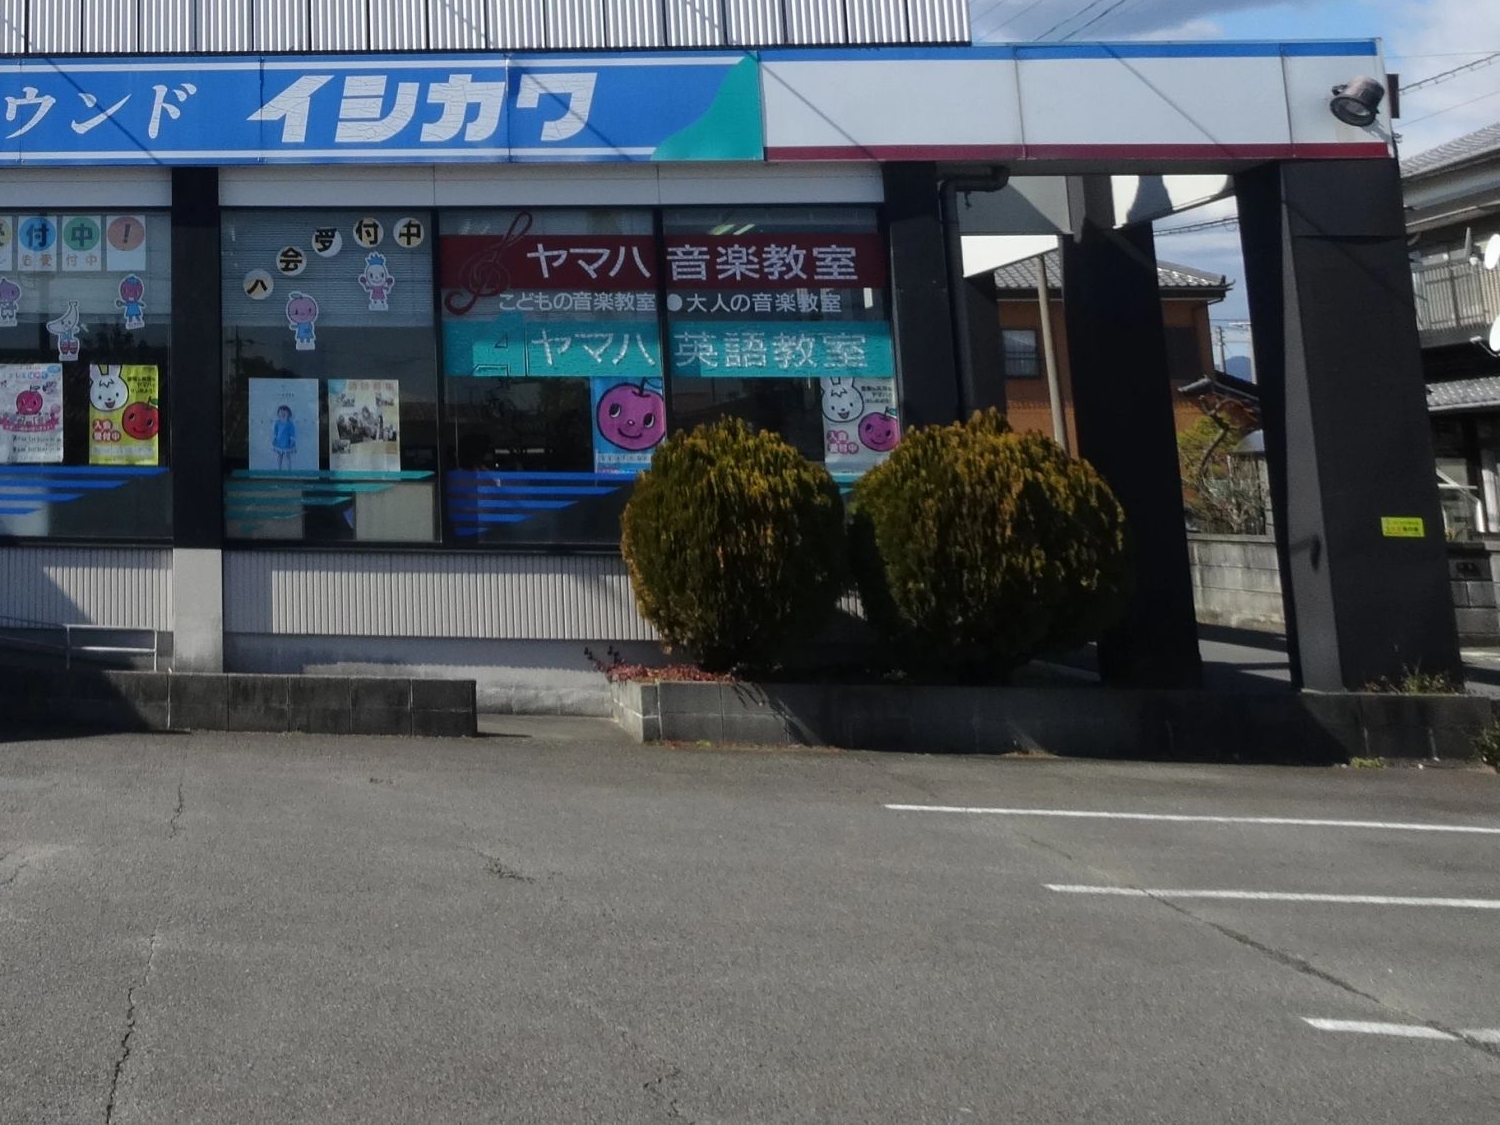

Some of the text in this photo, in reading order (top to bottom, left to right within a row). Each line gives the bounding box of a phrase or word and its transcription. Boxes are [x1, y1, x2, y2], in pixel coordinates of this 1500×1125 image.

[246, 72, 598, 144] イシカワ
[526, 243, 859, 281] ヤマハ 音楽教室
[499, 290, 656, 312] こどもの音楽教室
[531, 329, 869, 369] ヤマハ 英語教室
